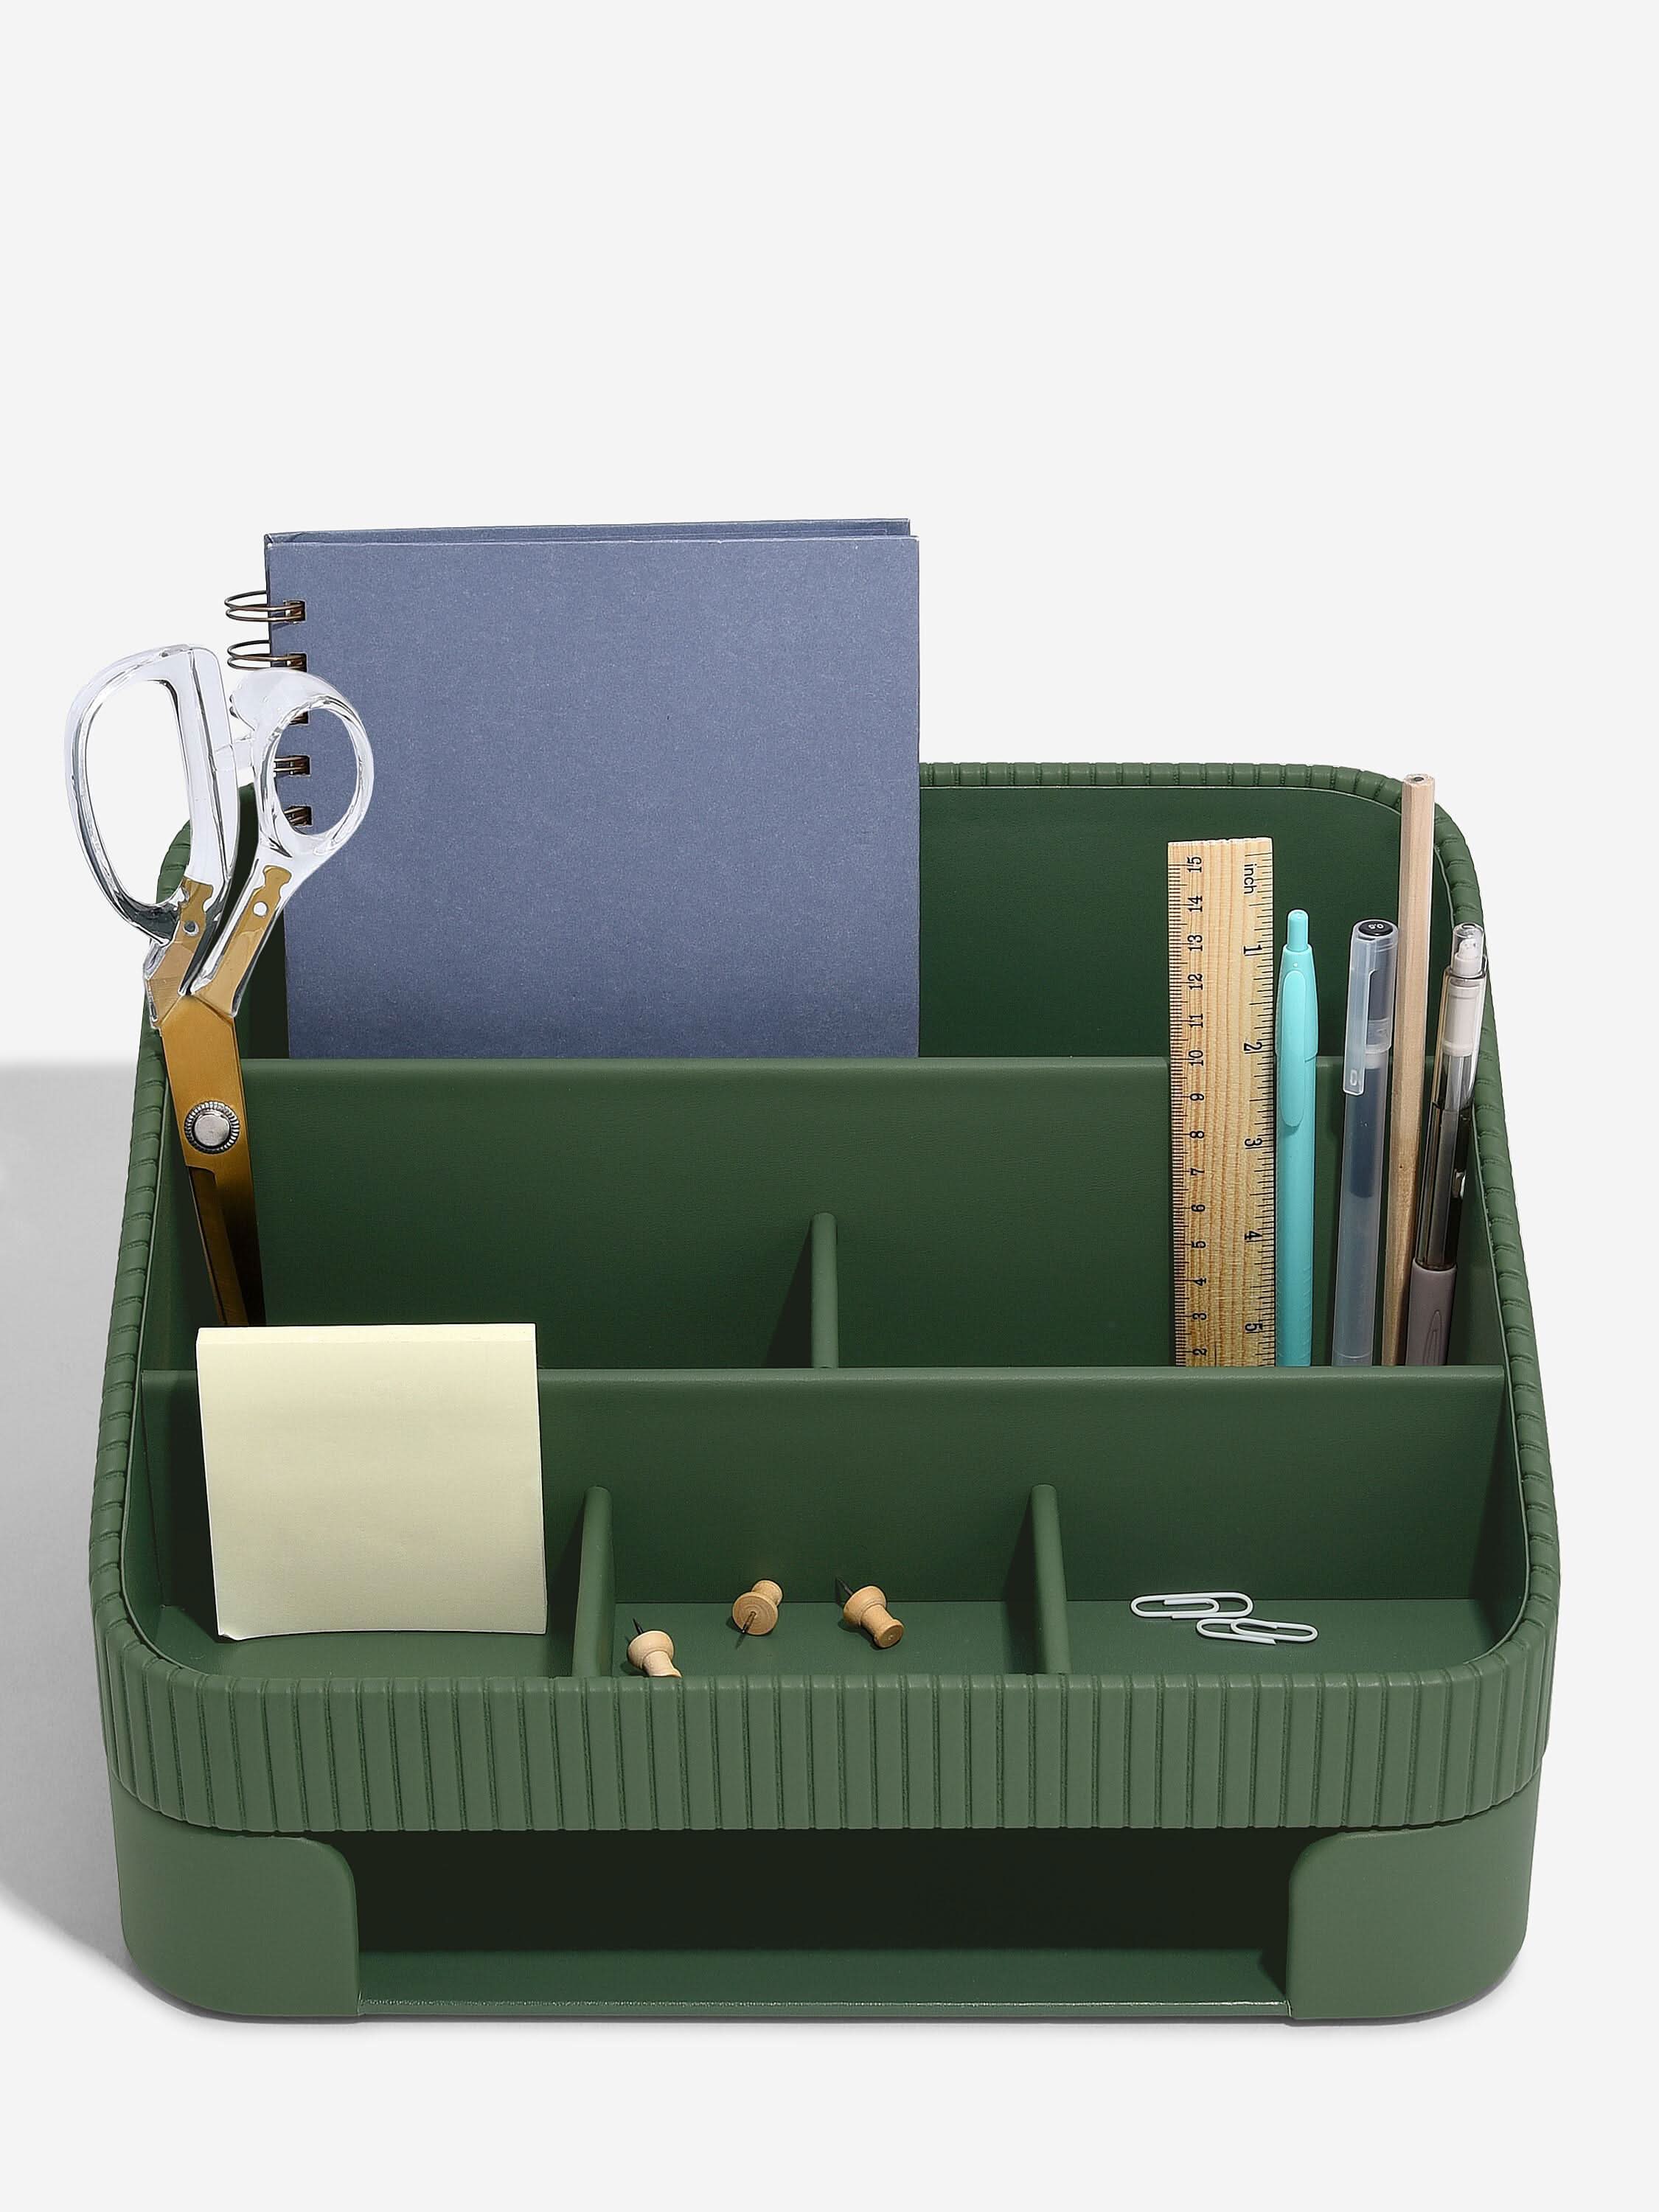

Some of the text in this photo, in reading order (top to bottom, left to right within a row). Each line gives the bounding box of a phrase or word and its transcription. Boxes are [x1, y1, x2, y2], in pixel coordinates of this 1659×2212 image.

[1187, 856, 1203, 873] 15
[1243, 864, 1258, 894] inch
[1188, 895, 1203, 912] 14
[1188, 934, 1203, 951] 13
[1243, 945, 1262, 955] 1
[1188, 973, 1203, 990] 12
[1189, 1013, 1203, 1028] 11
[1243, 1041, 1262, 1052] 2
[1189, 1049, 1204, 1066] 10
[1189, 1093, 1205, 1102] 9
[1189, 1130, 1205, 1139] 8
[1245, 1138, 1263, 1147] 3
[1190, 1168, 1205, 1176] 7
[1191, 1204, 1206, 1212] 6
[1245, 1231, 1263, 1240] 4
[1192, 1241, 1206, 1249] 5
[1192, 1278, 1207, 1286] 4
[1192, 1312, 1207, 1321] 3
[1245, 1321, 1263, 1332] 5
[1192, 1348, 1207, 1356] 2
